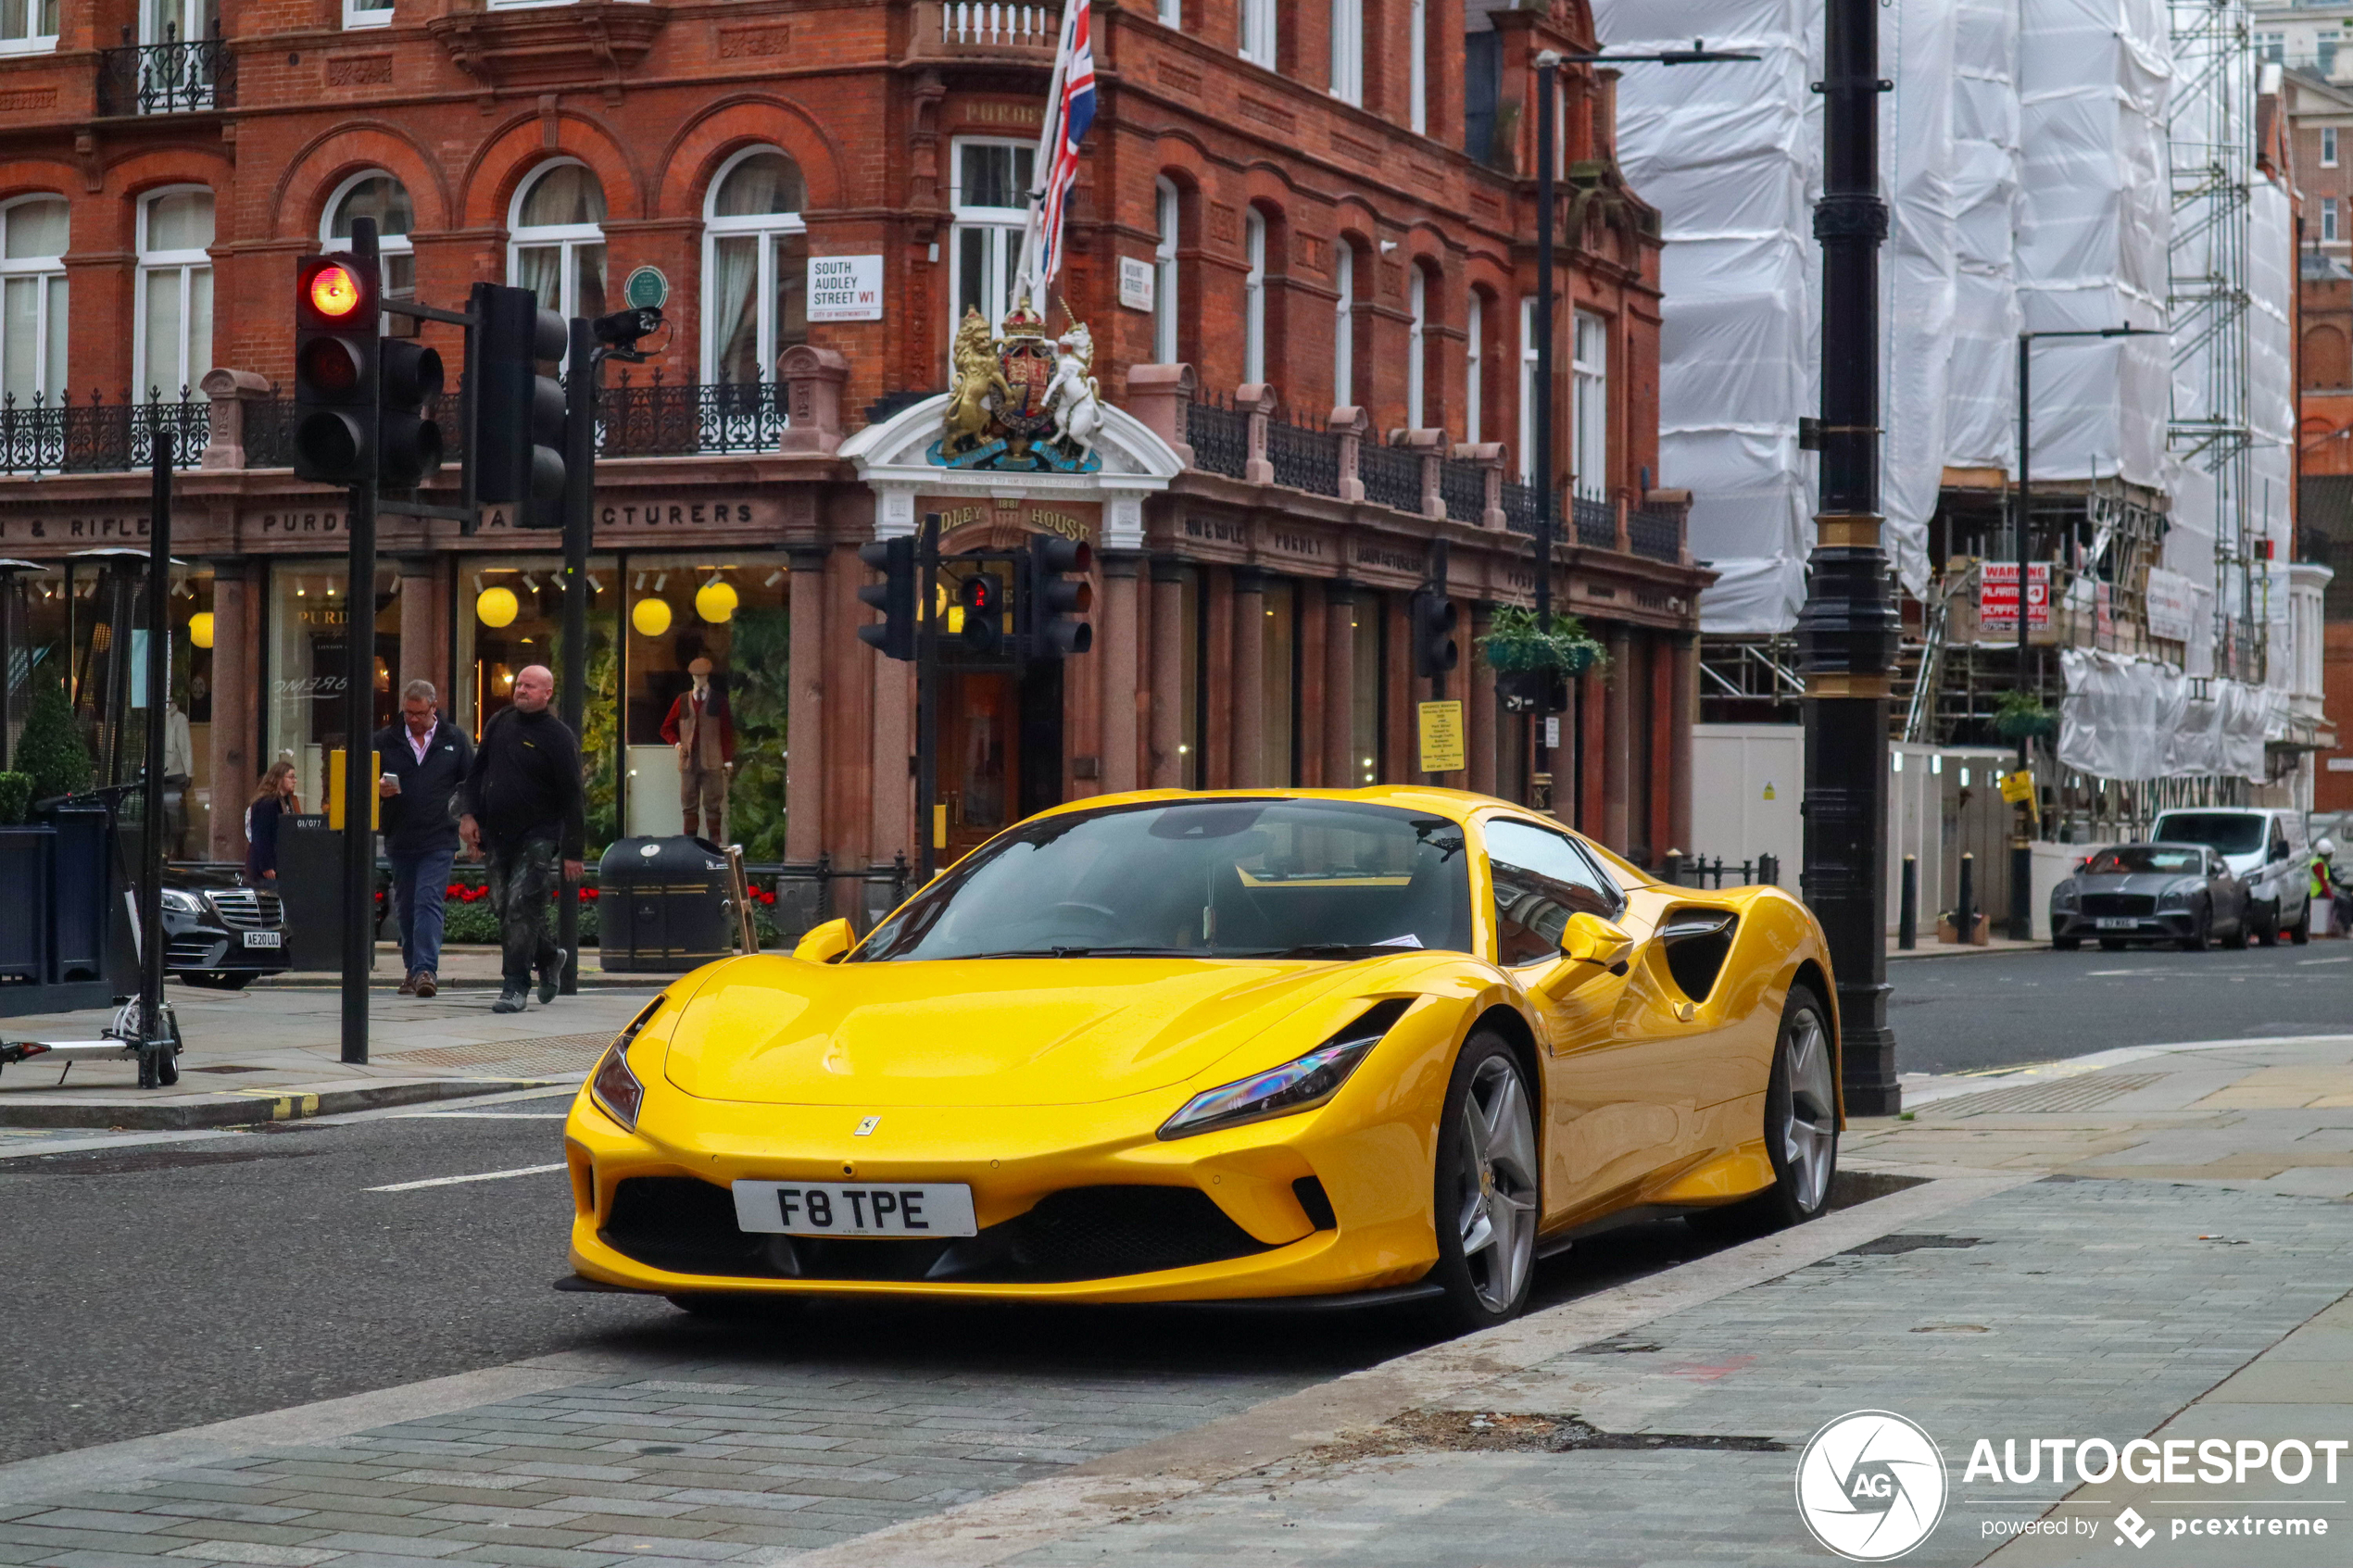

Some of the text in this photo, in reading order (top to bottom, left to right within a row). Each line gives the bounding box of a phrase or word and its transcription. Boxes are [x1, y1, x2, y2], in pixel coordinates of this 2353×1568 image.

[814, 261, 851, 275] SOUTH
[814, 277, 858, 290] AUDLEY
[813, 291, 875, 306] STREET W1
[998, 499, 1018, 508] 1881
[31, 519, 45, 537] &
[918, 507, 1090, 543] ADLEY HOUSE
[248, 934, 267, 946] AE20
[776, 1188, 929, 1229] F8 TPE
